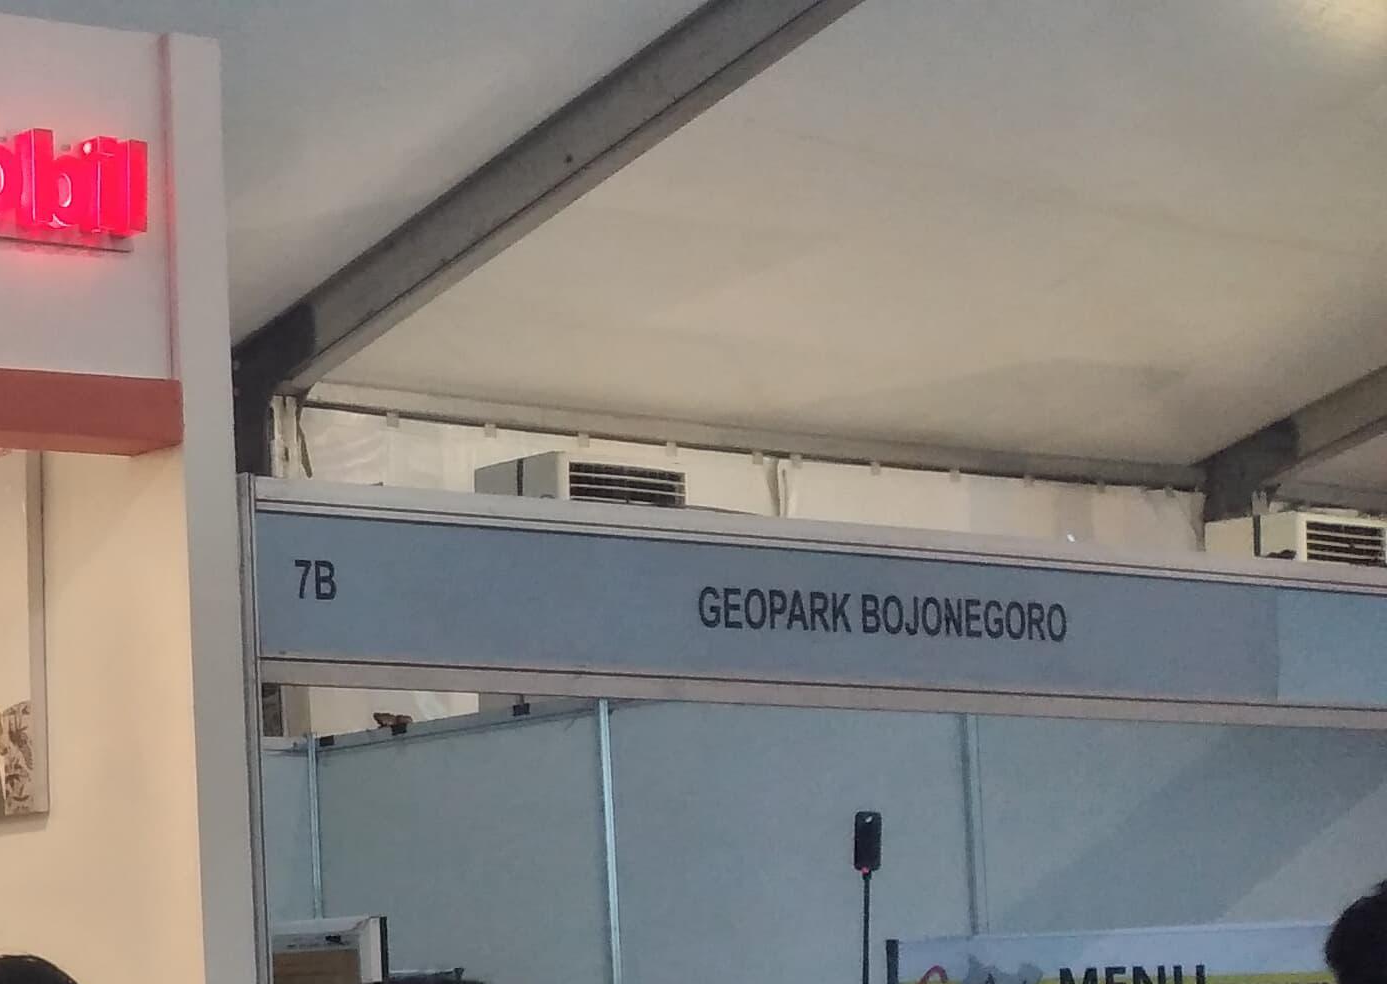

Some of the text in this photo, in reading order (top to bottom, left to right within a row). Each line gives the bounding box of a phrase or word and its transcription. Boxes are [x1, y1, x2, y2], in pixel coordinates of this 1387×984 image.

[294, 559, 337, 600] 7B
[698, 586, 1068, 642] GEOPARK BOJONEGORO
